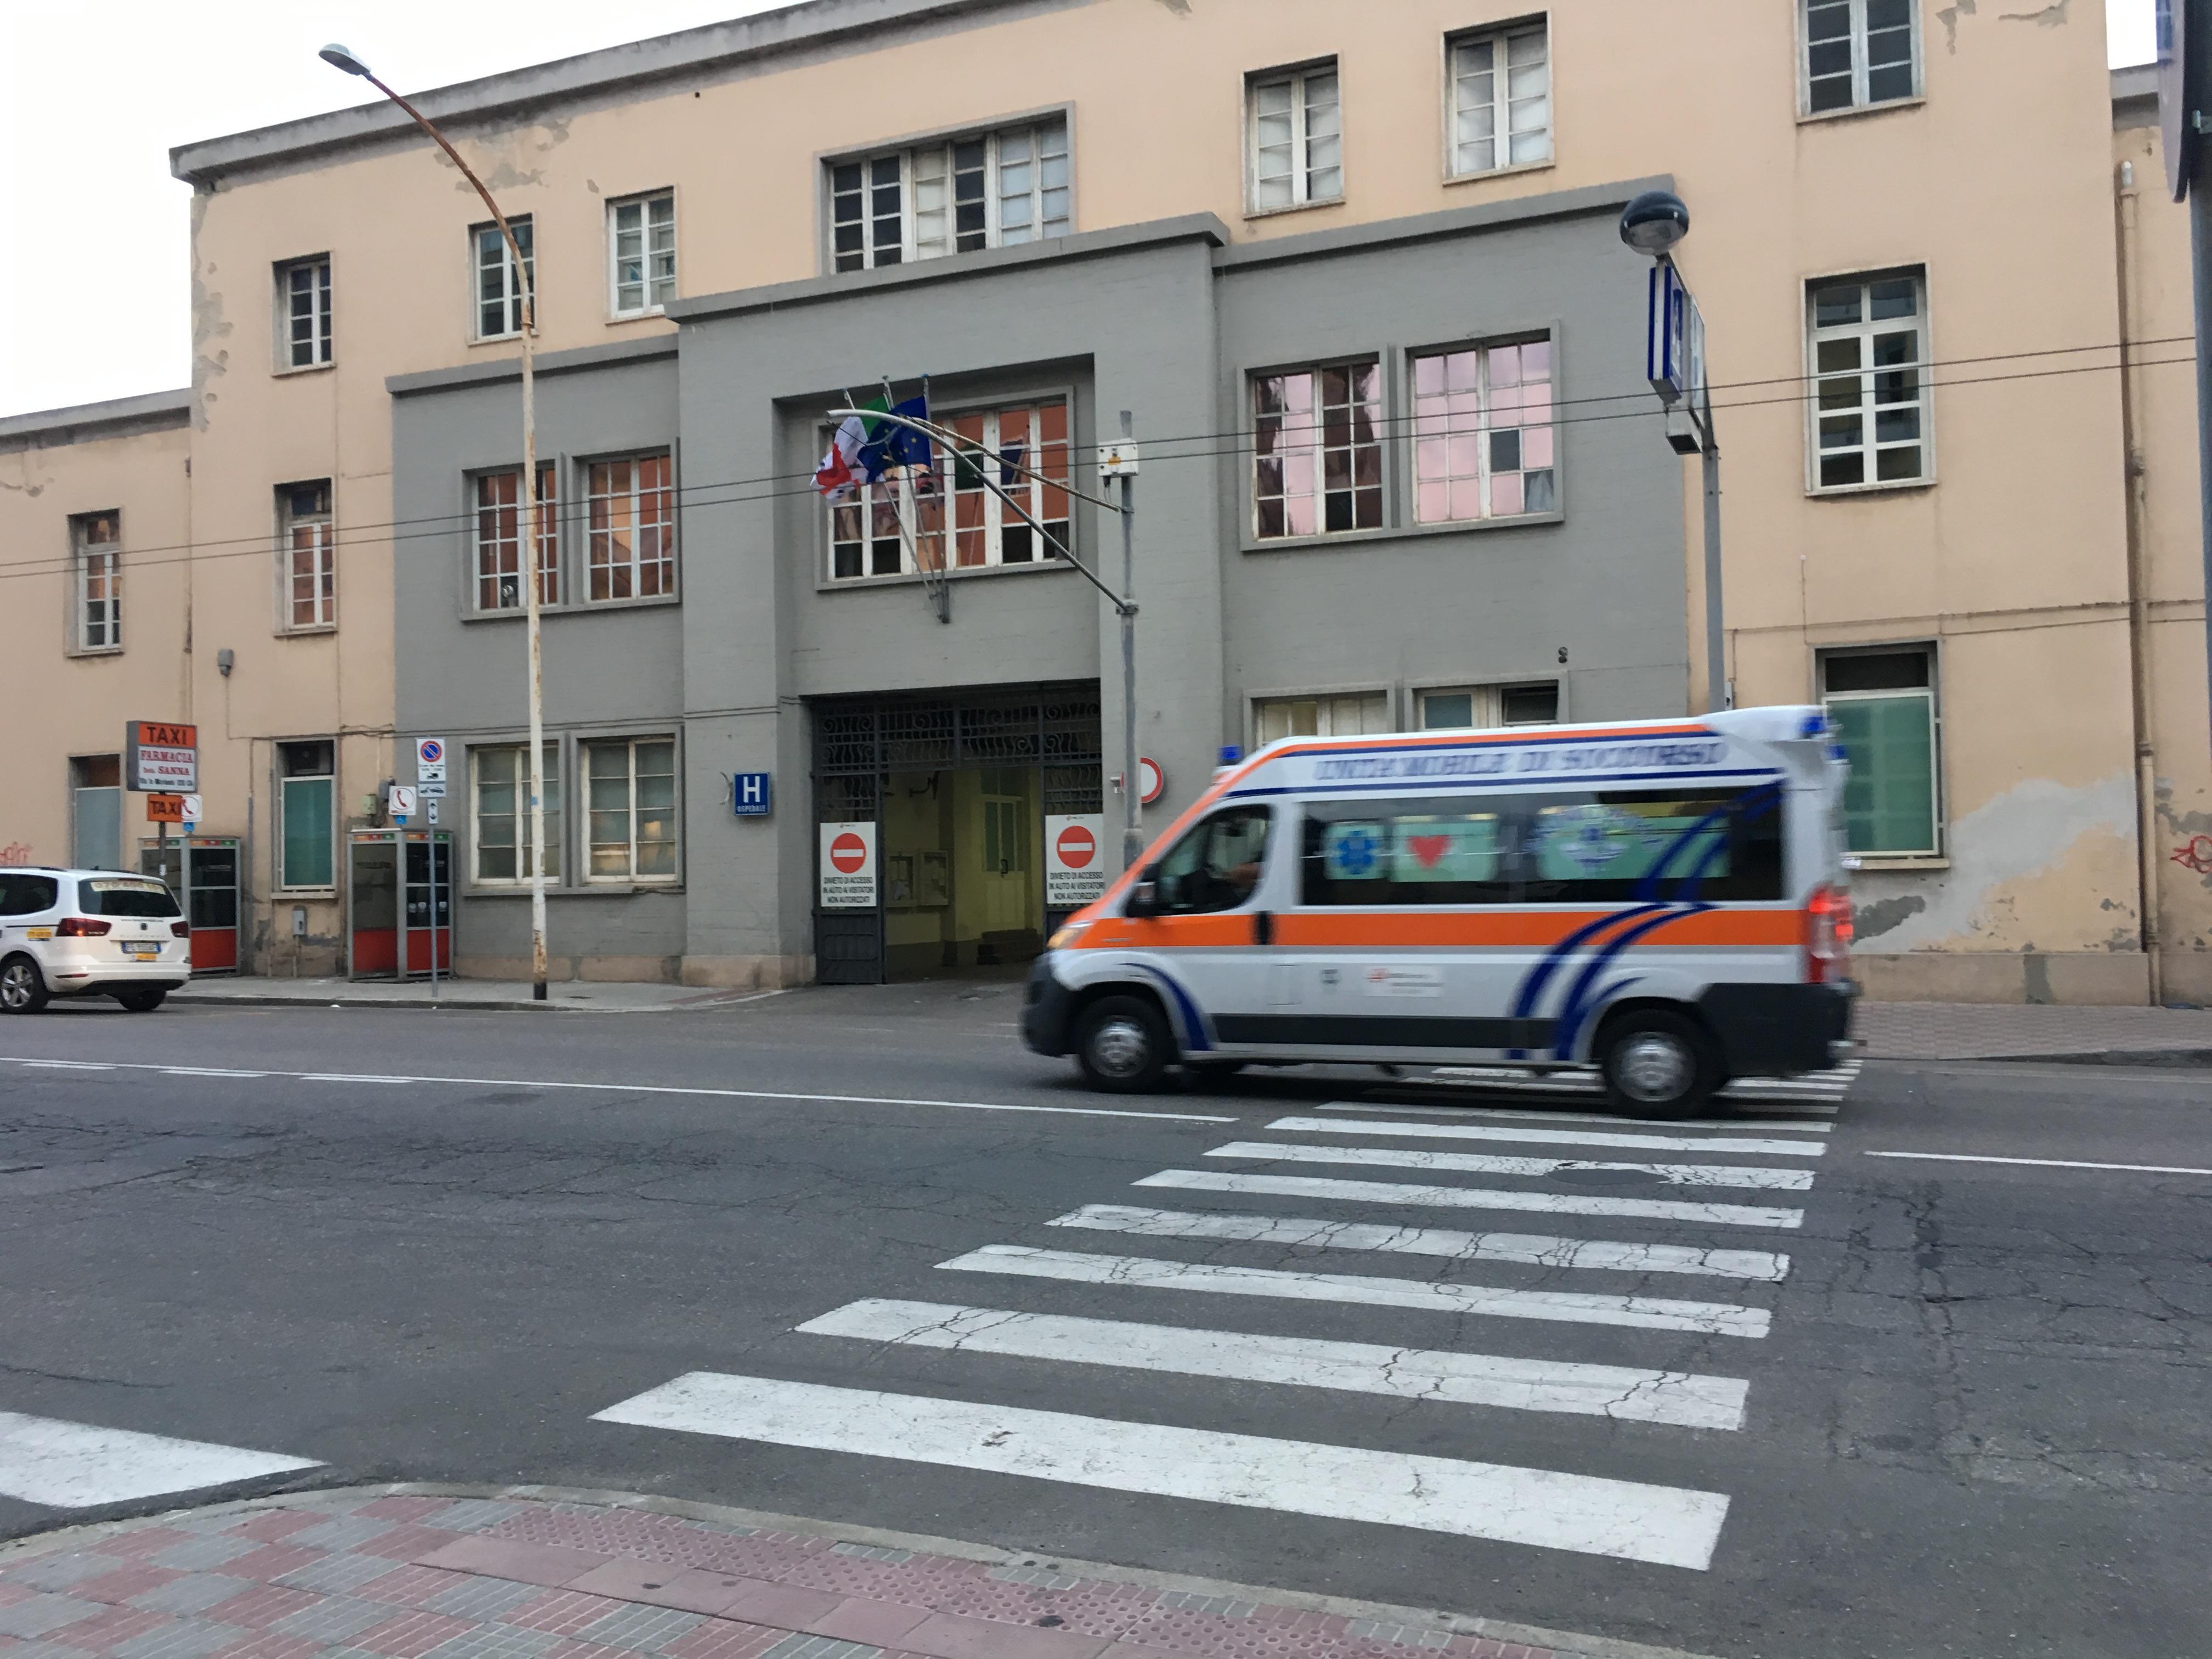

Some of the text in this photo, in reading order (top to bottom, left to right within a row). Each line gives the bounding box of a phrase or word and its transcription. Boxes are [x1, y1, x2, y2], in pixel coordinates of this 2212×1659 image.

[147, 726, 187, 745] TAXI
[140, 750, 193, 763] FARMACIA
[157, 766, 190, 776] SANNA
[743, 776, 760, 803] H
